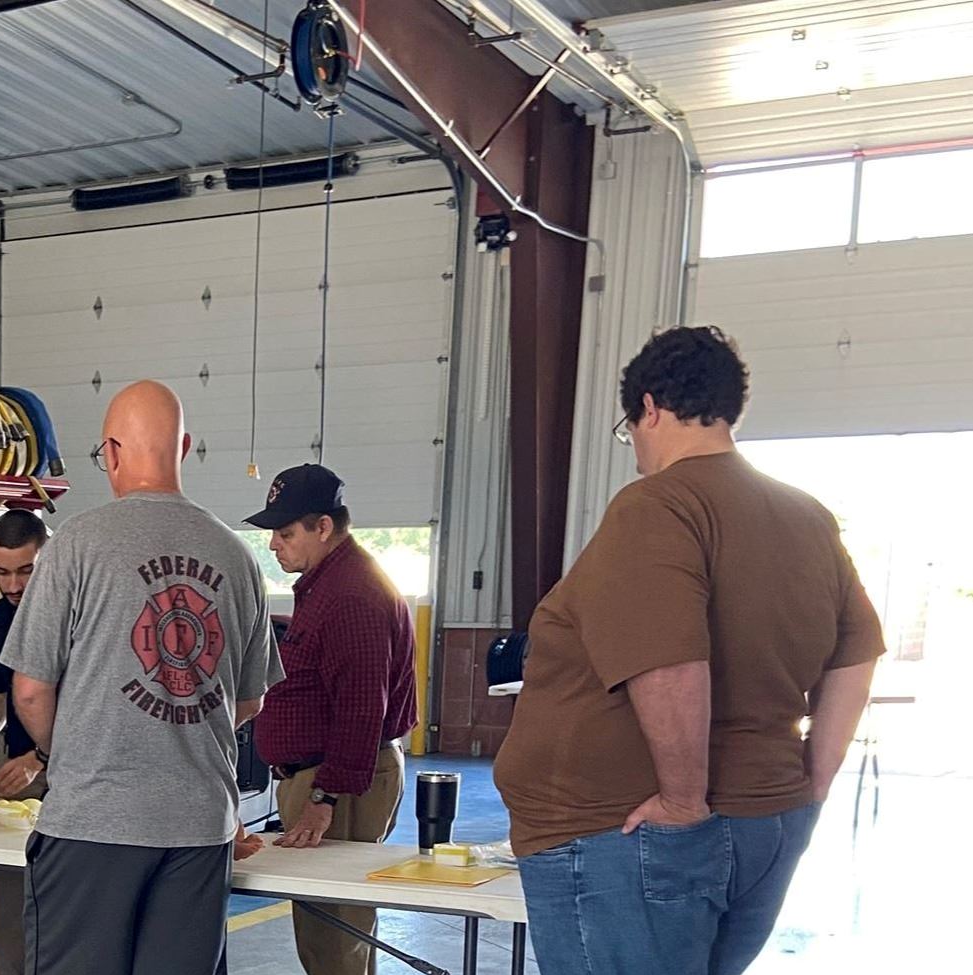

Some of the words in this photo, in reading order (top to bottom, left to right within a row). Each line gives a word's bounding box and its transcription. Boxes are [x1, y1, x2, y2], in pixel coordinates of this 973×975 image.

[137, 555, 225, 593] FEDERAL
[172, 589, 190, 609] A
[141, 625, 153, 652] I
[206, 631, 219, 656] F
